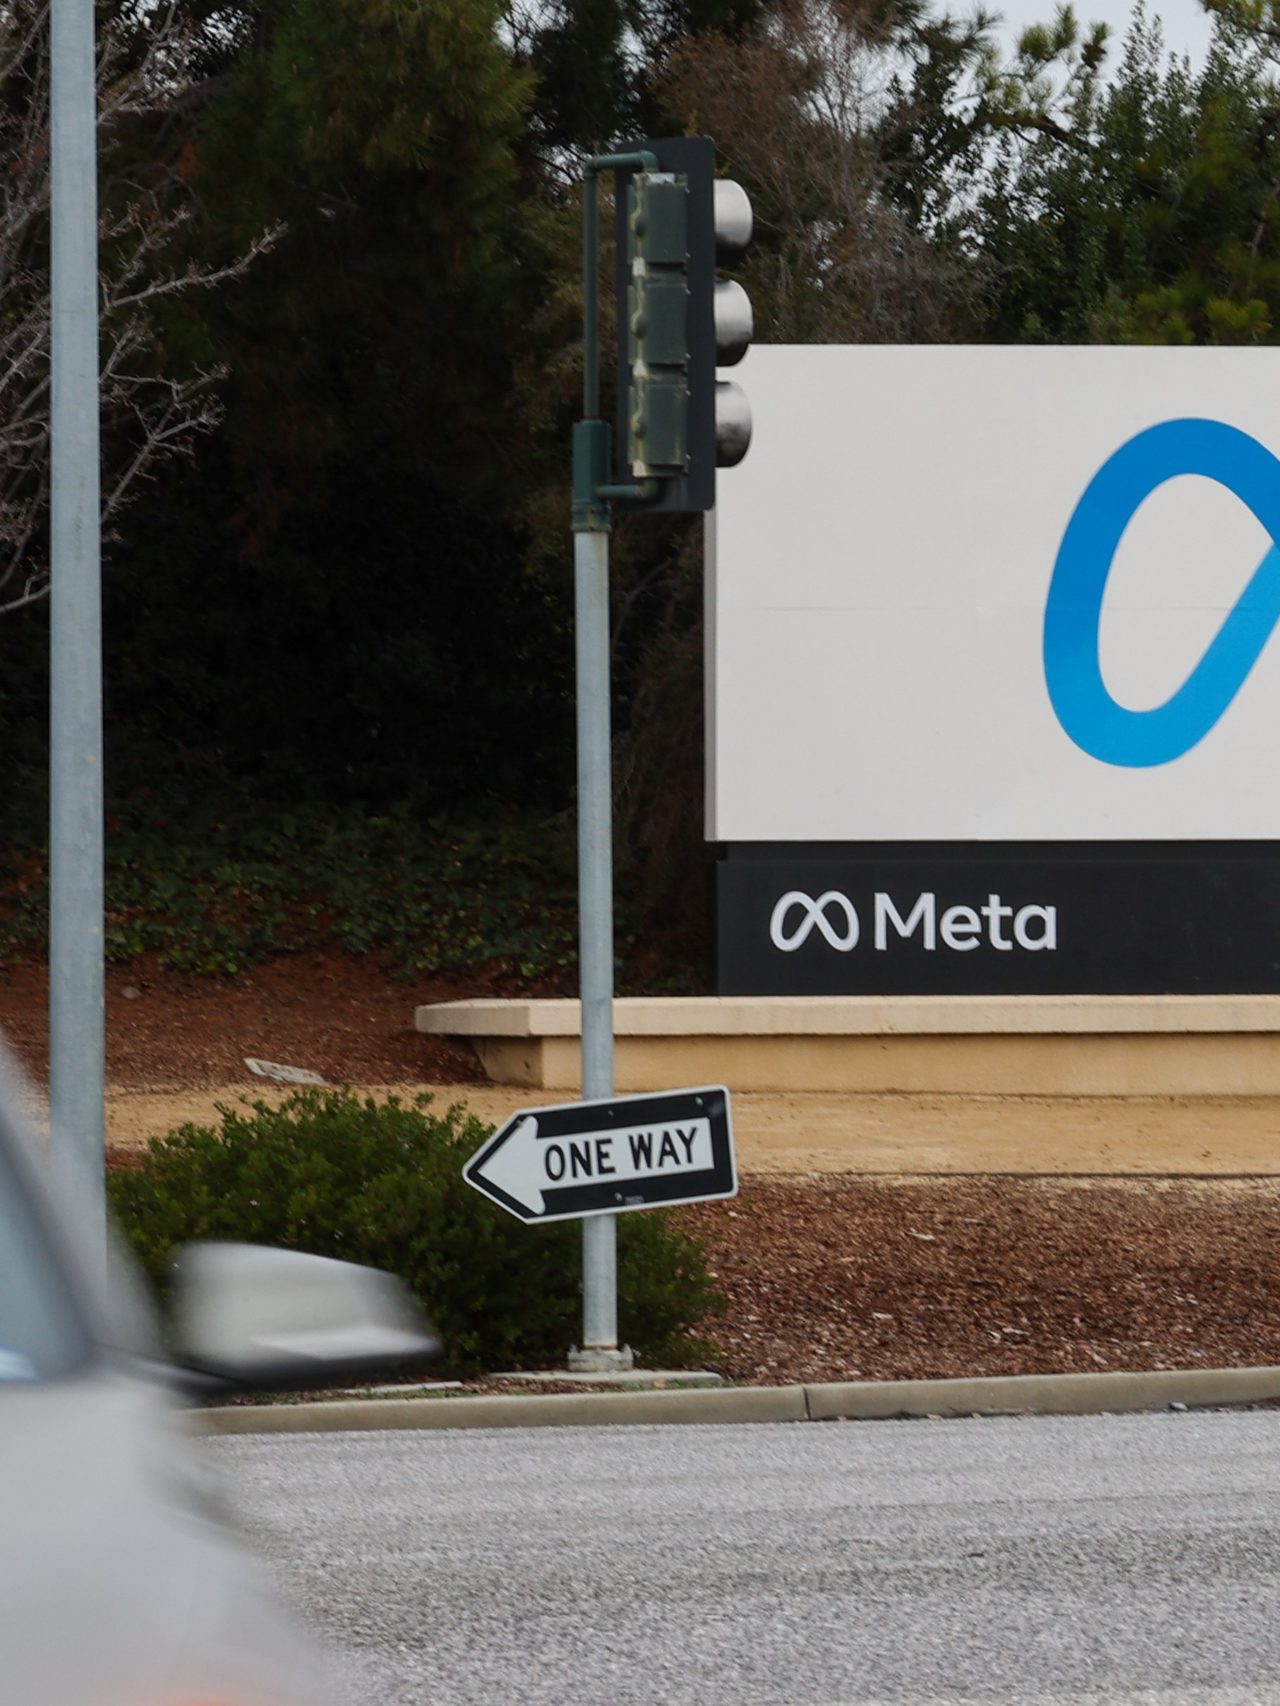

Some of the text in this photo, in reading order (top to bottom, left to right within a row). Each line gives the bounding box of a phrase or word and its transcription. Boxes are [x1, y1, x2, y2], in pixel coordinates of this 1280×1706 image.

[874, 892, 1057, 951] Meta
[544, 1127, 698, 1182] ONE WAY
